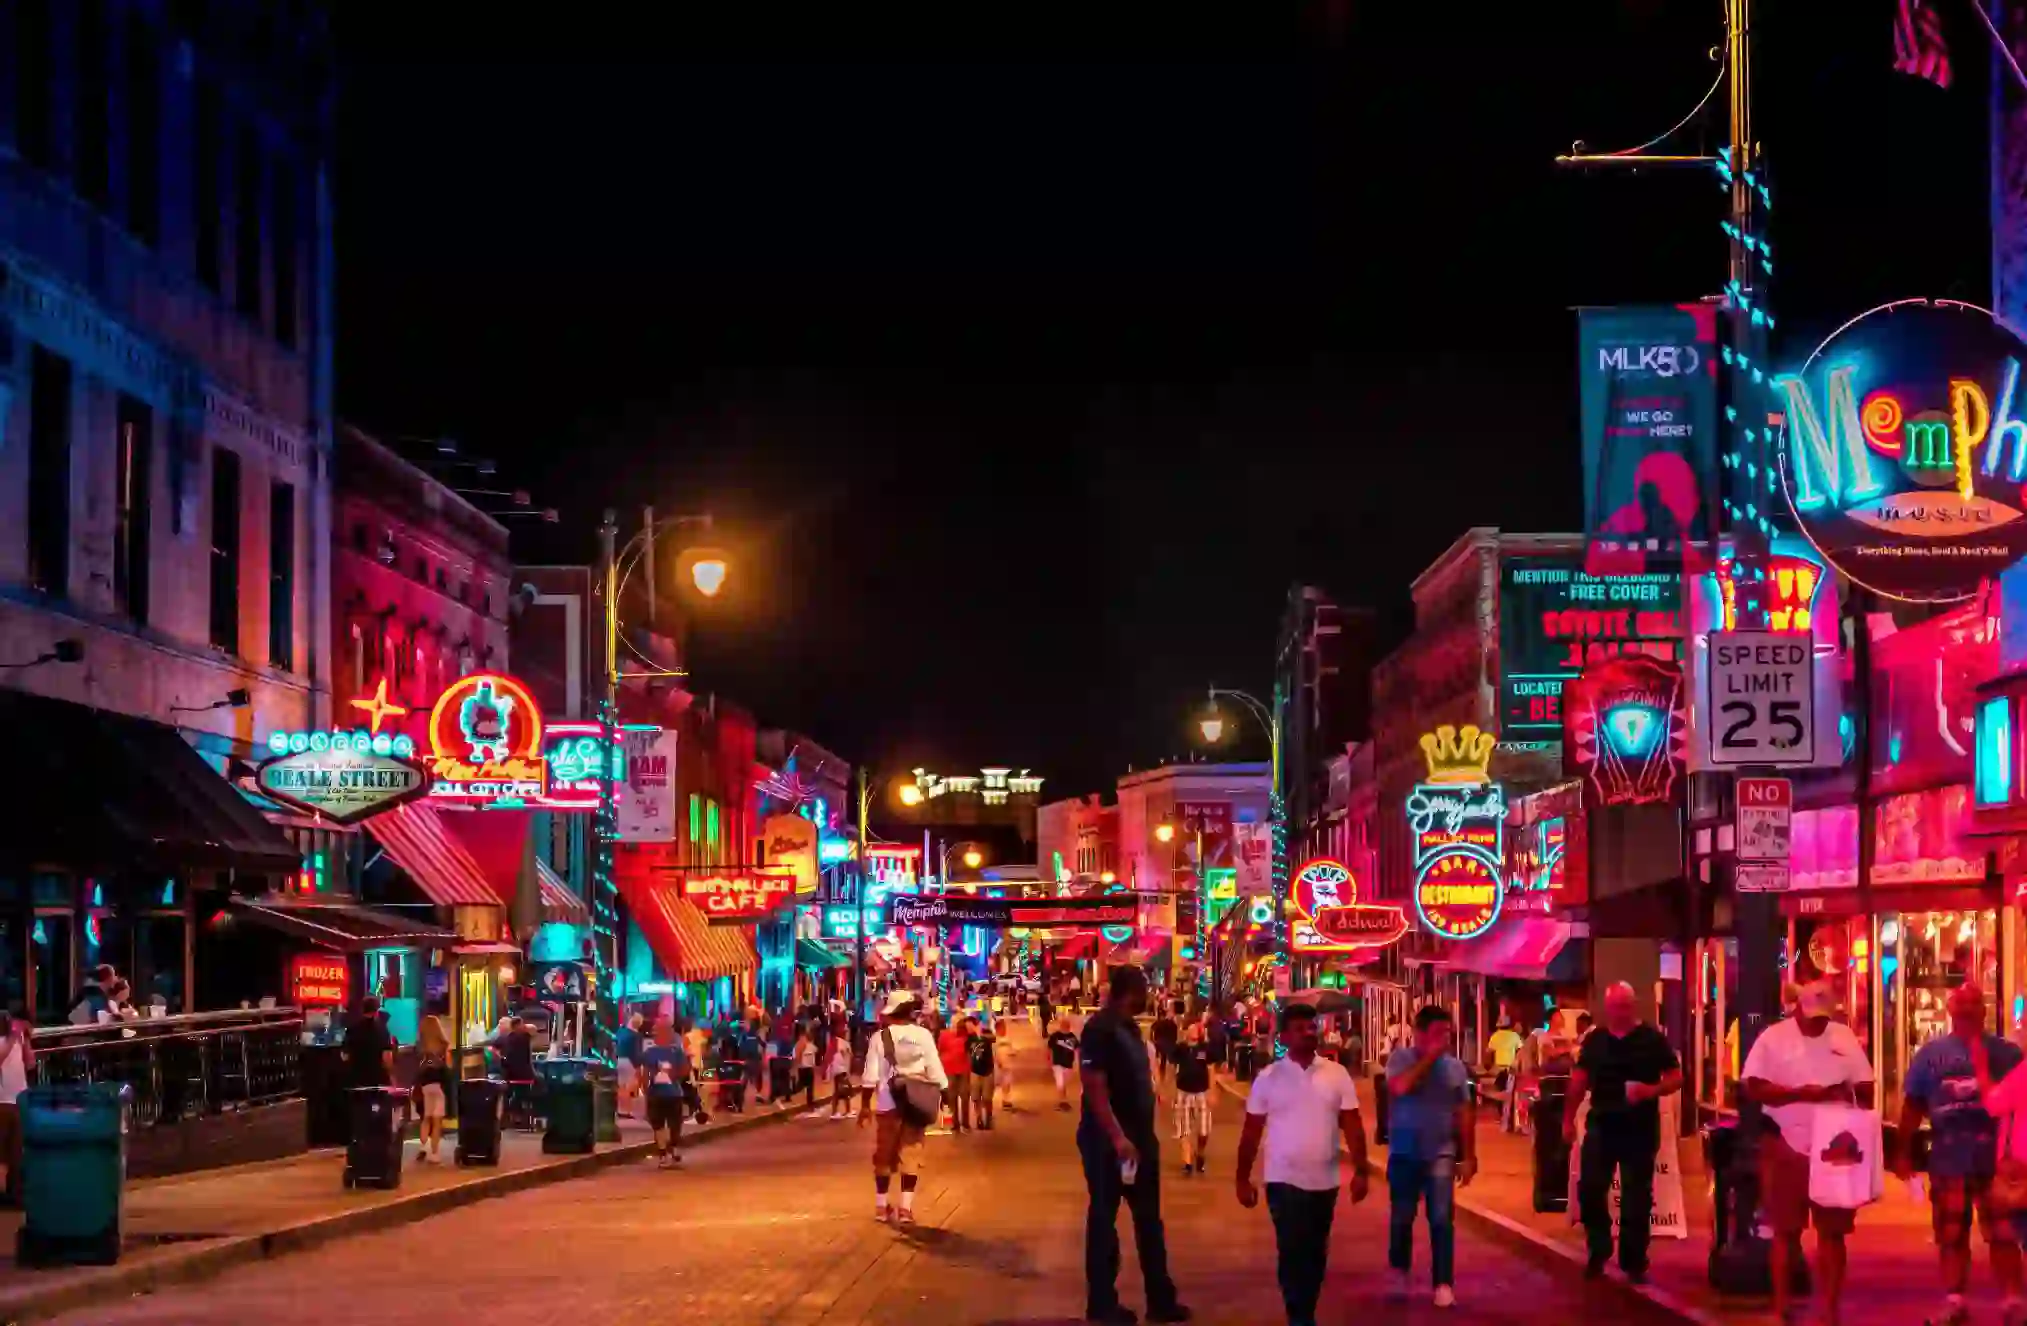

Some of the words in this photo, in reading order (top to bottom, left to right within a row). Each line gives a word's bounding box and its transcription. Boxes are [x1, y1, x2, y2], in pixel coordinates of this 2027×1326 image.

[1626, 411, 1649, 423] WE
[1652, 411, 1674, 423] GO
[1570, 584, 1606, 600] FREE
[1609, 584, 1660, 600] COVER
[1718, 645, 1805, 666] SPEED
[1728, 673, 1795, 694] LIMIT
[1721, 701, 1804, 748] 25
[339, 770, 411, 787] STREET
[1749, 783, 1780, 801] NO
[1440, 855, 1478, 875] BAR
[708, 894, 768, 911] CAFE
[300, 965, 344, 980] FROZEN
